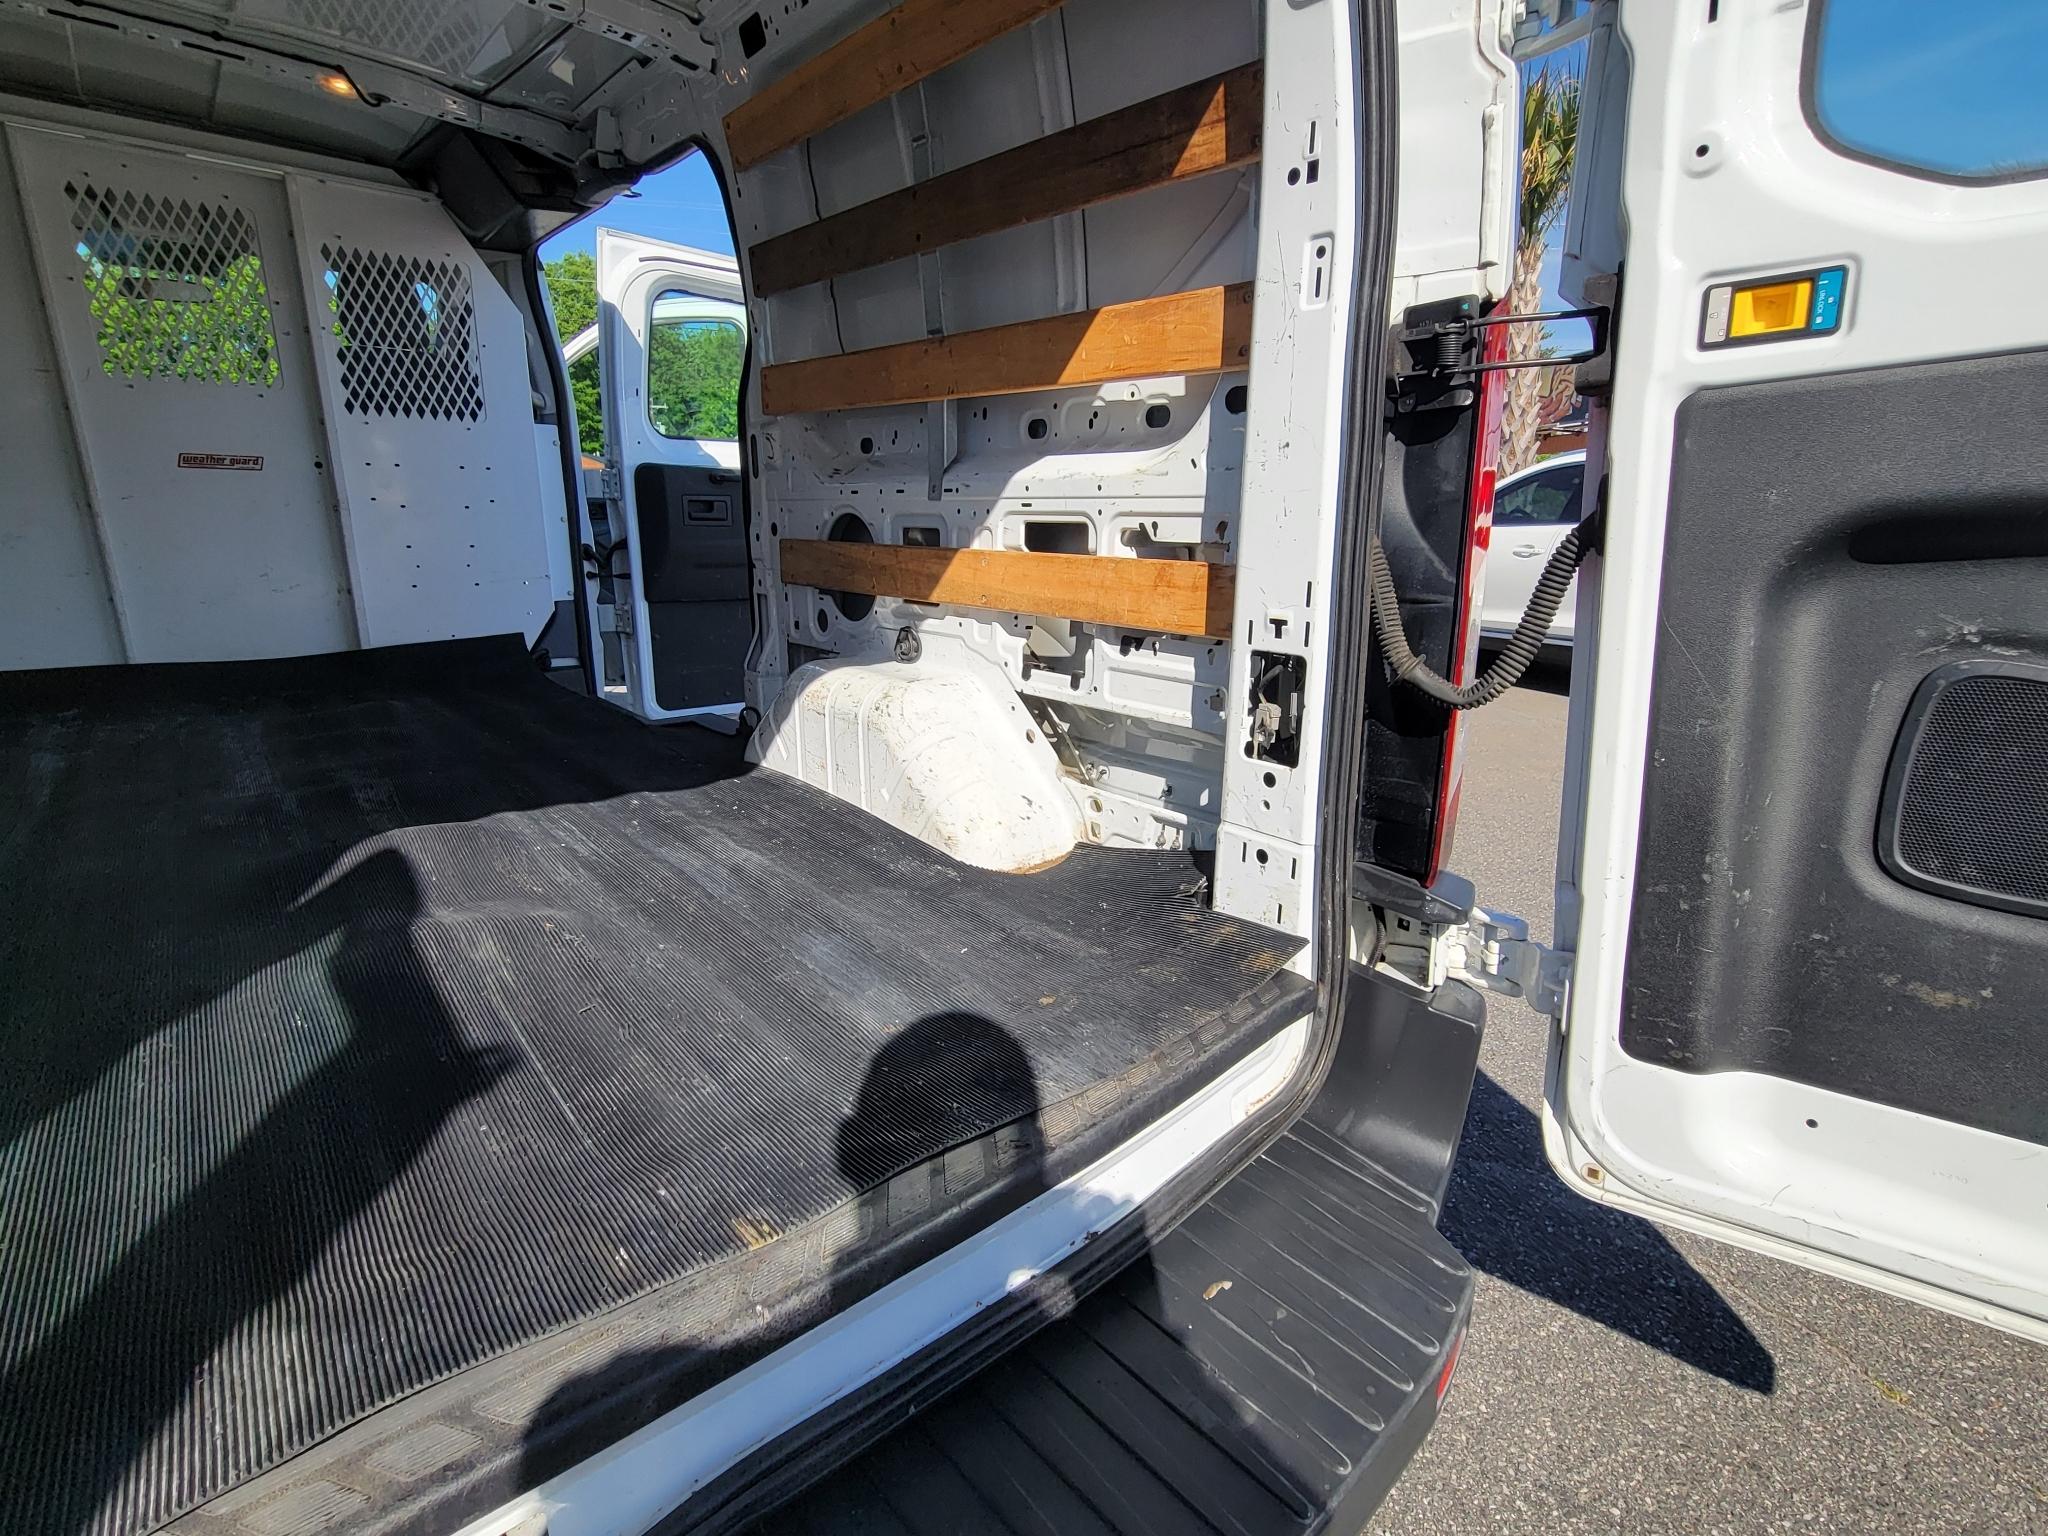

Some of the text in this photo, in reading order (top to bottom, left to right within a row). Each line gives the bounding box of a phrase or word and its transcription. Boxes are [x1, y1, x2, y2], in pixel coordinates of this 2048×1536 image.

[1817, 289, 1826, 314] UNLOCK
[182, 455, 259, 466] weather guard
